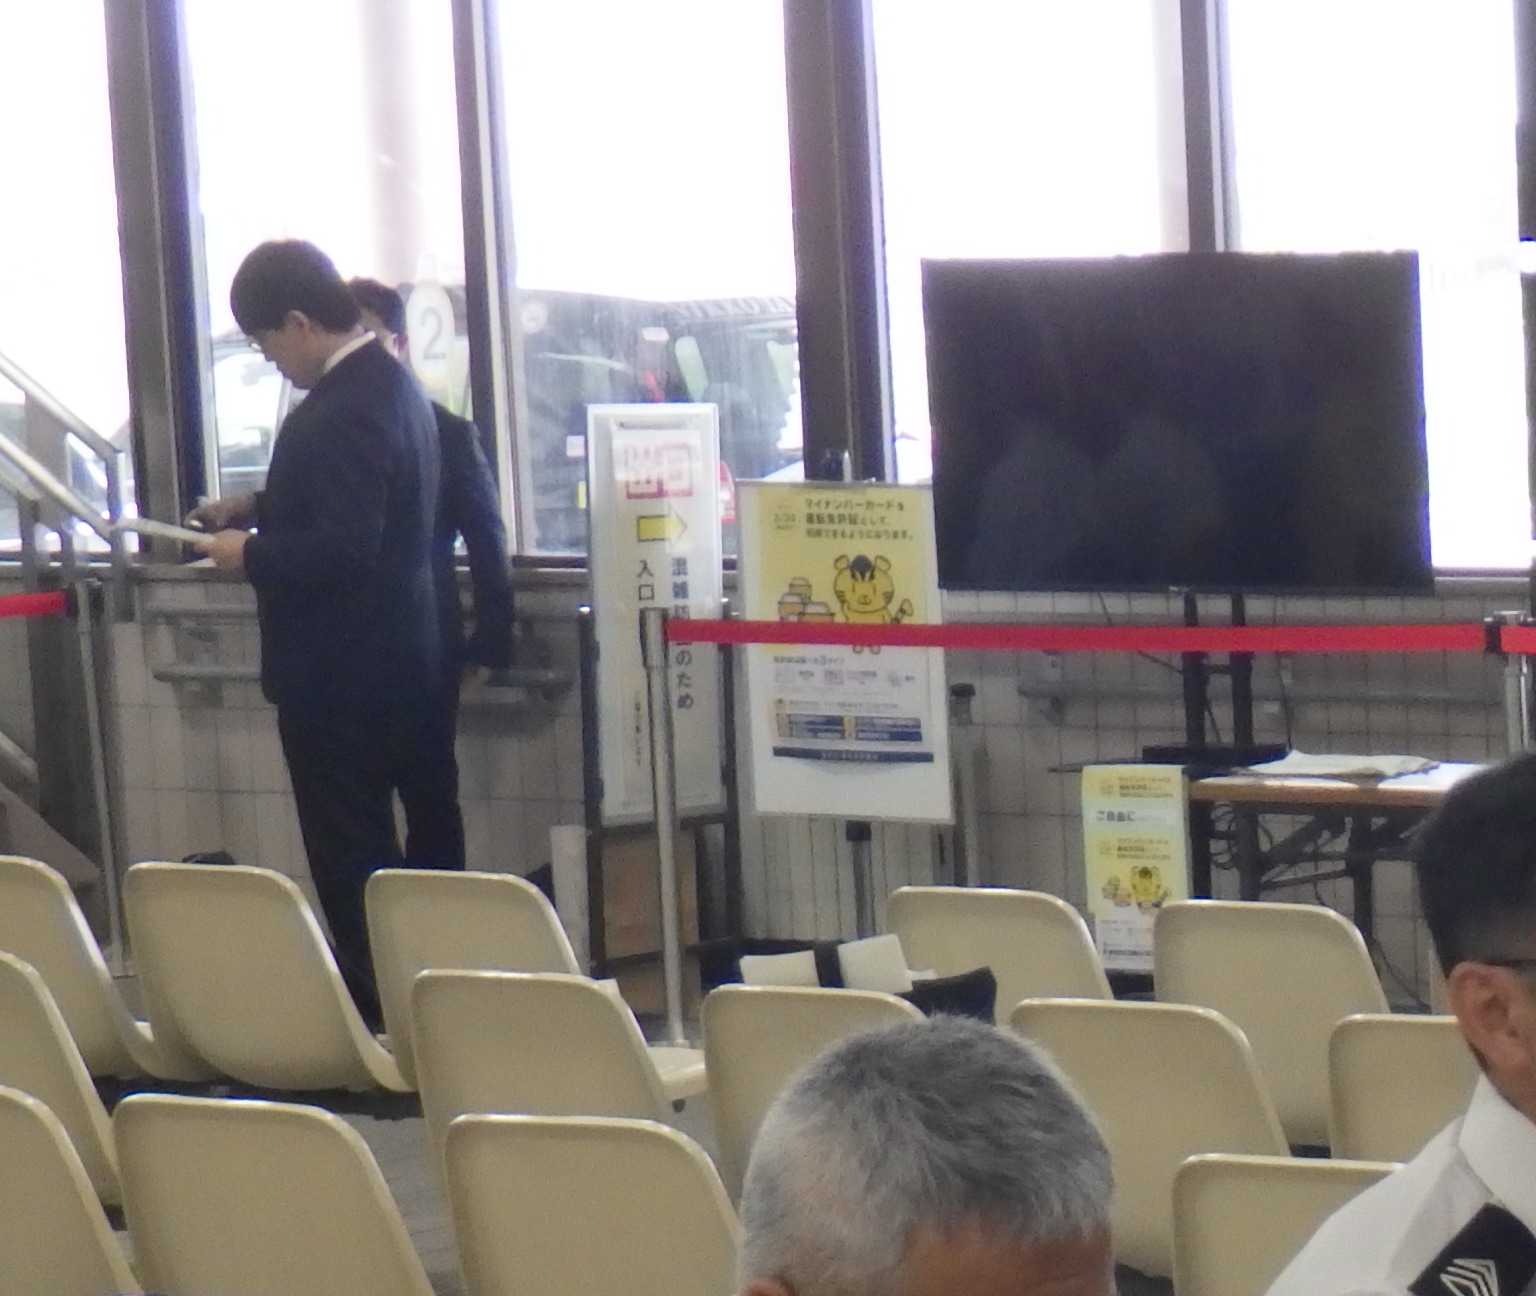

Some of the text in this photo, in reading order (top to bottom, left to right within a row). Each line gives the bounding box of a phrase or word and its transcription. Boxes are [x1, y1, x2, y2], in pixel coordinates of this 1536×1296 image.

[420, 306, 446, 360] 2
[636, 559, 655, 602] 入口
[671, 556, 694, 711] 混雑防のため
